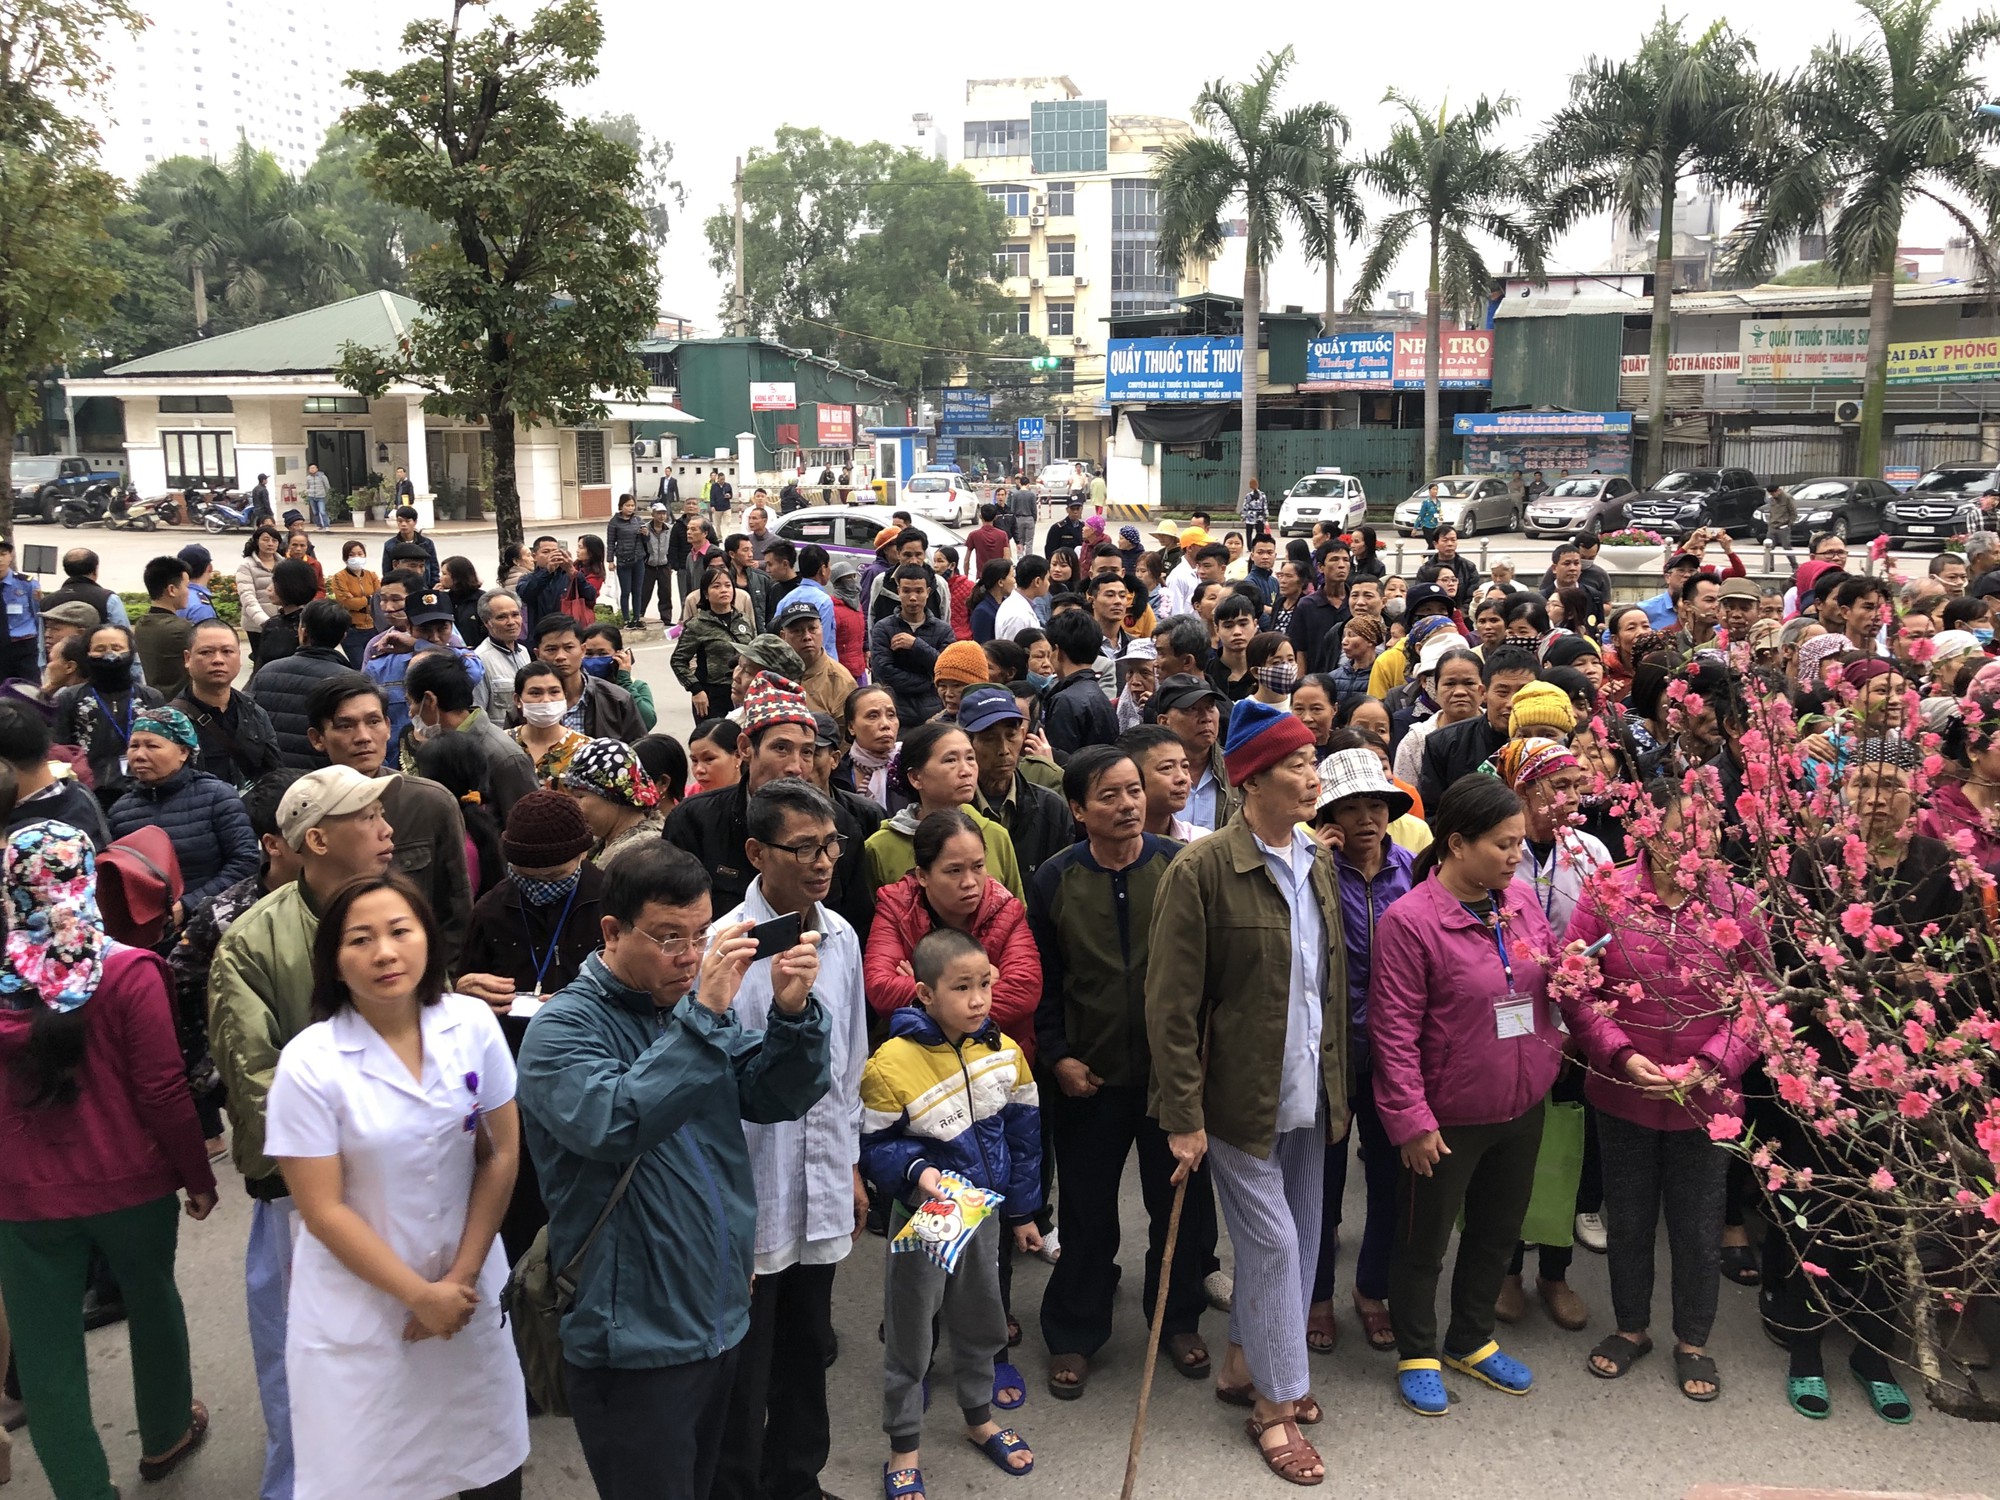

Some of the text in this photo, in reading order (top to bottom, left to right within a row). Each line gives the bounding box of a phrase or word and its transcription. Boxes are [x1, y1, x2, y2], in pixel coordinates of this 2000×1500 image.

[1314, 334, 1392, 357] QUẦY THUỐC
[1795, 324, 1823, 346] THUỐC
[1110, 339, 1244, 376] QUẦY THUỐC THẾ THỦY
[1448, 337, 1490, 357] TRỌ
[1909, 345, 1938, 360] ĐÂY
[1446, 356, 1478, 365] DÂN
